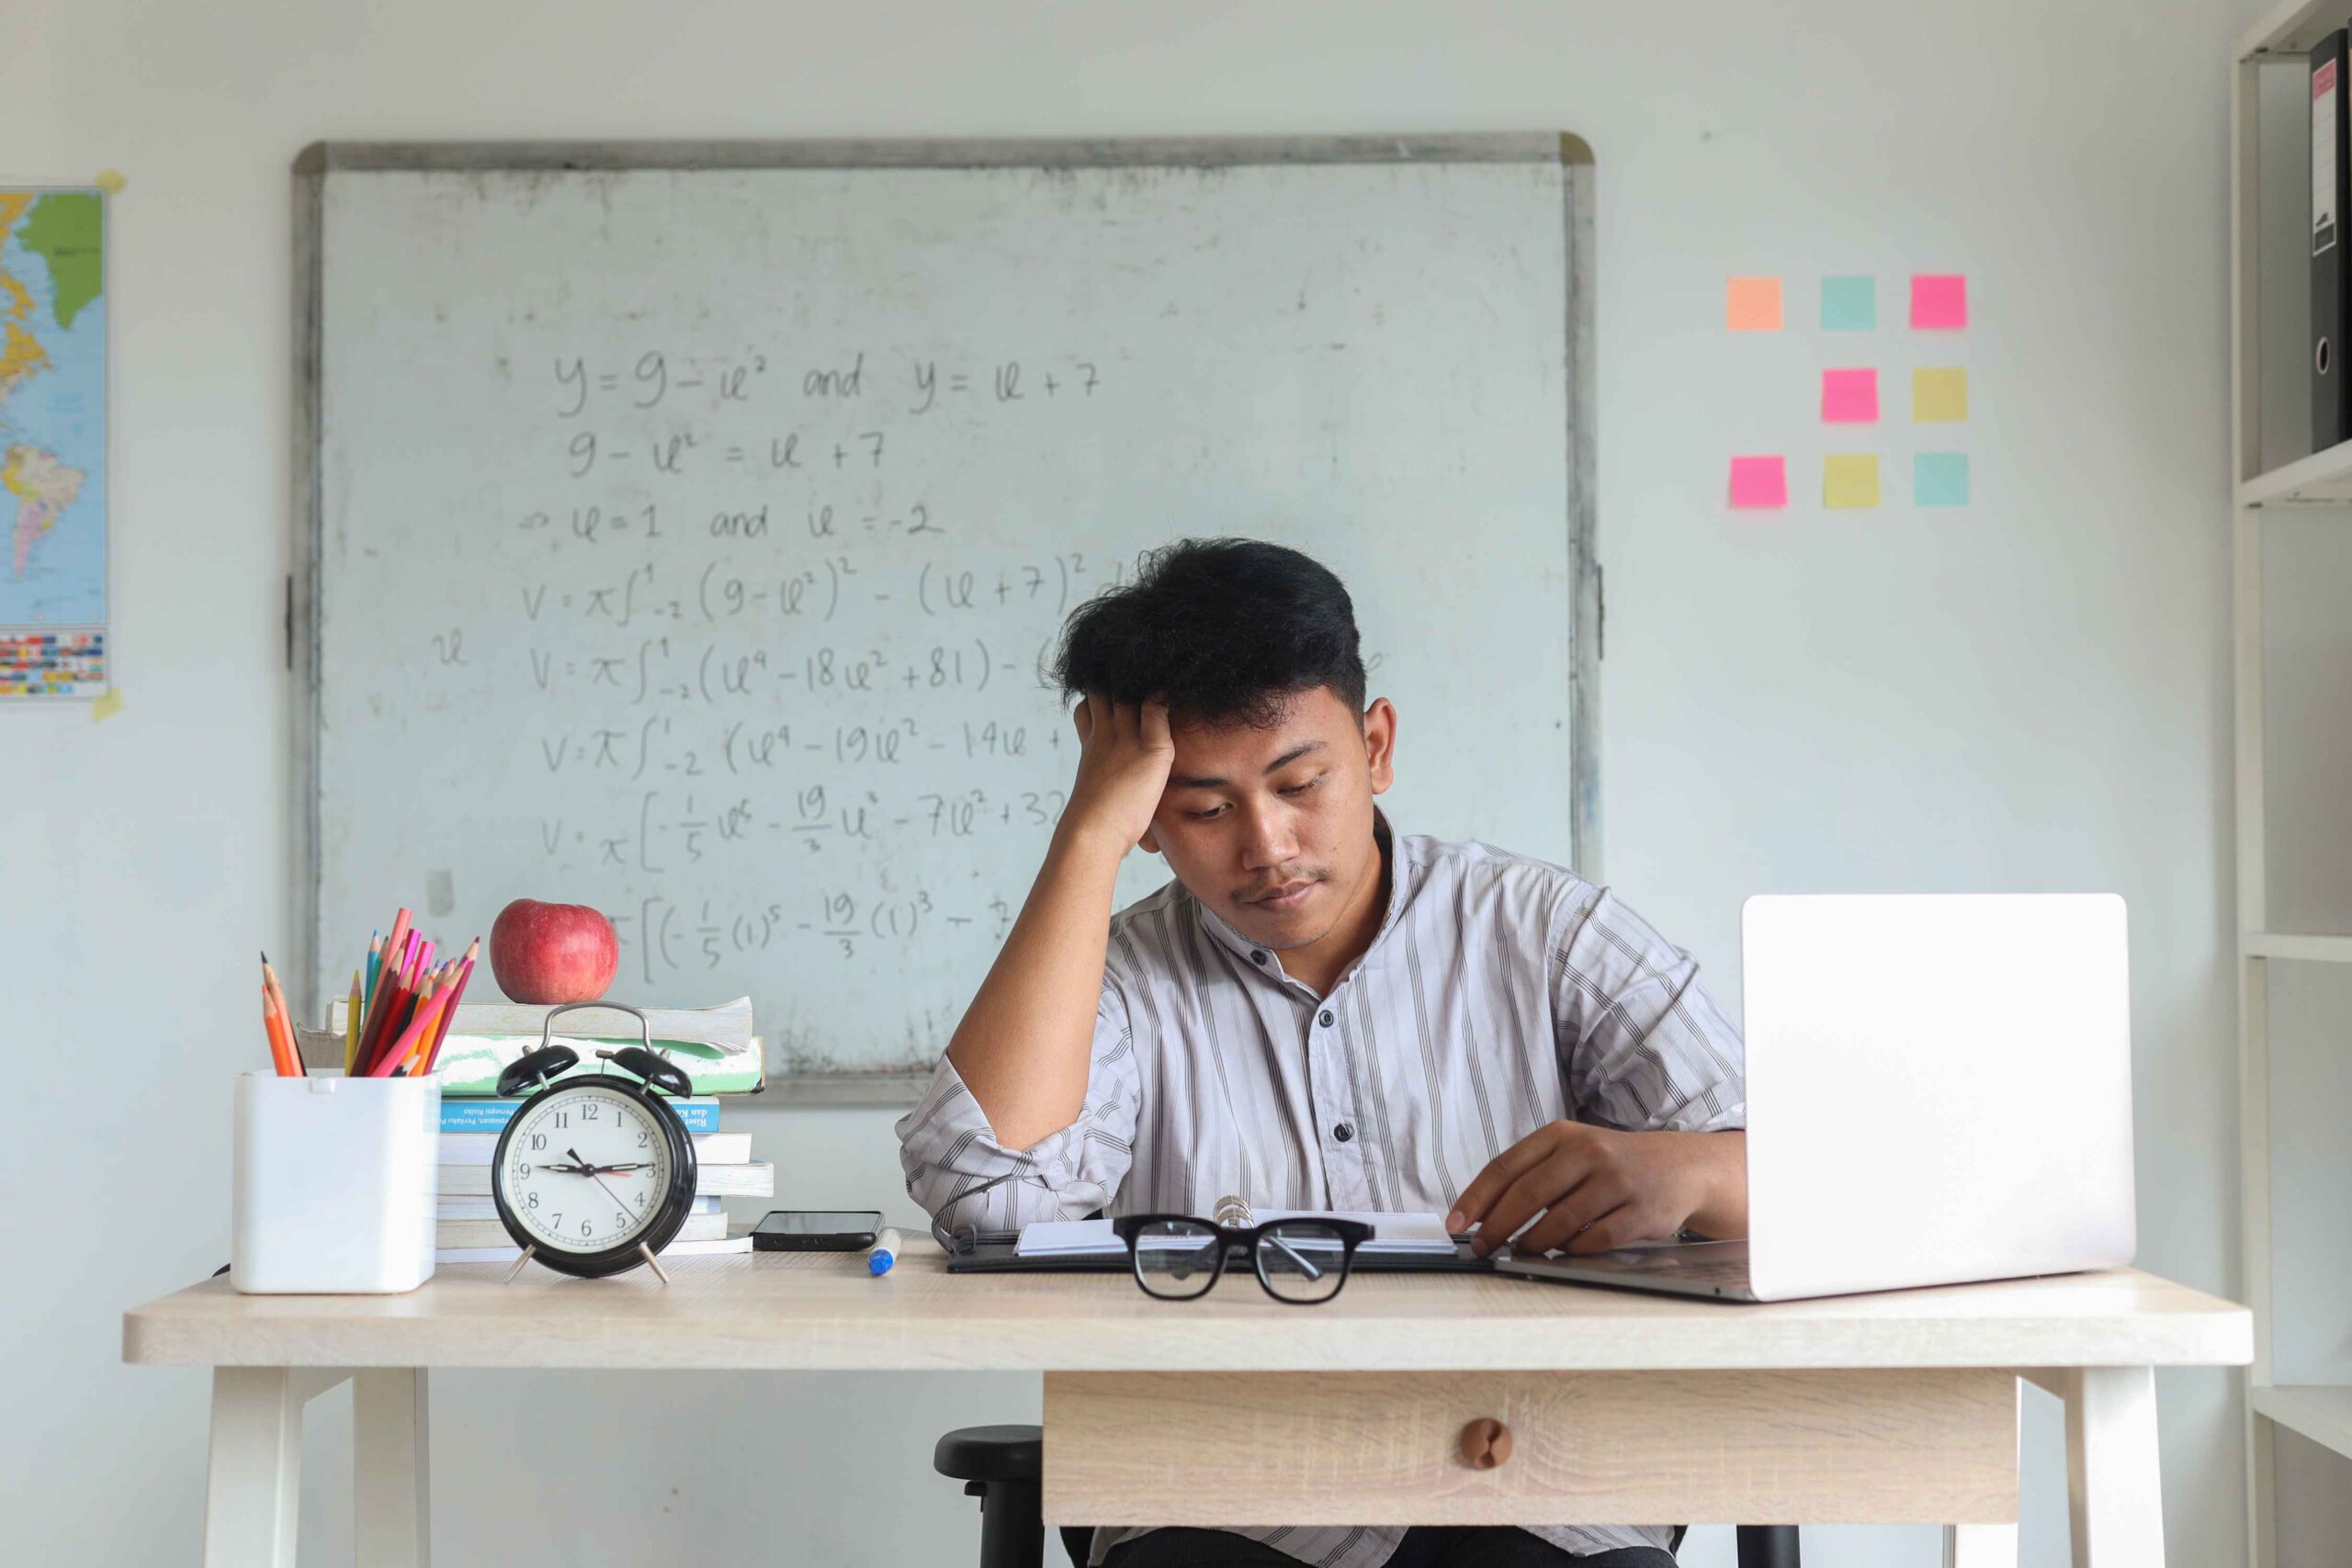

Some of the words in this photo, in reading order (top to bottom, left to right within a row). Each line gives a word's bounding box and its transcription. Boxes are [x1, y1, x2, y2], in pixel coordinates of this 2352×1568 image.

[802, 351, 864, 398] and
[709, 502, 769, 539] and
[477, 1116, 509, 1125] epuasan,
[553, 1111, 569, 1129] 11
[581, 1103, 598, 1121] 12
[616, 1111, 623, 1128] 1
[691, 1109, 707, 1118] dan
[530, 1133, 548, 1151] 10
[636, 1132, 648, 1148] 2
[520, 1162, 531, 1181] 9
[645, 1161, 657, 1179] 3
[527, 1191, 539, 1209] 8
[634, 1190, 646, 1207] 4
[551, 1213, 562, 1230] 7
[581, 1219, 593, 1237] 6
[616, 1212, 627, 1229] 5
